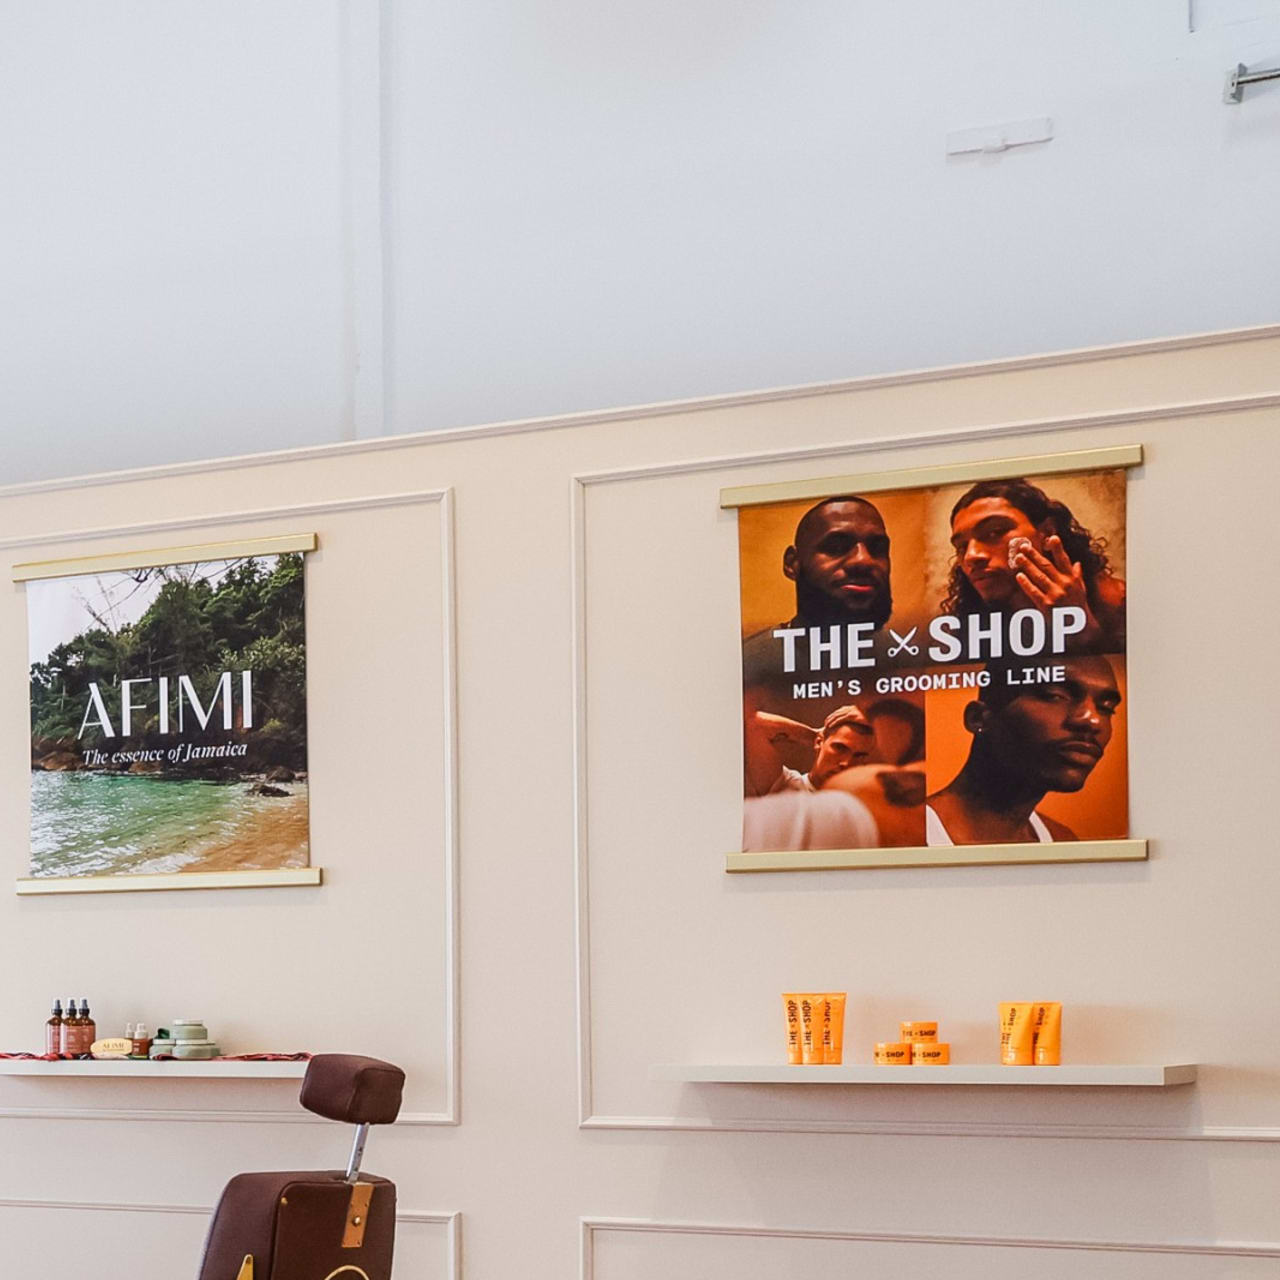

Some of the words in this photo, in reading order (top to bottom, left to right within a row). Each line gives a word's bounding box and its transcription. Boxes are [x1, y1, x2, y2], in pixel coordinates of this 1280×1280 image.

[773, 621, 876, 673] THE
[928, 605, 1088, 663] SHOP
[77, 669, 253, 740] AFIMI
[793, 679, 862, 699] MEN'S
[876, 671, 991, 694] GROOMING
[1006, 665, 1066, 686] LINE
[83, 750, 108, 765] The
[111, 748, 164, 763] essence
[168, 744, 186, 763] of
[182, 740, 248, 762] Jamaica
